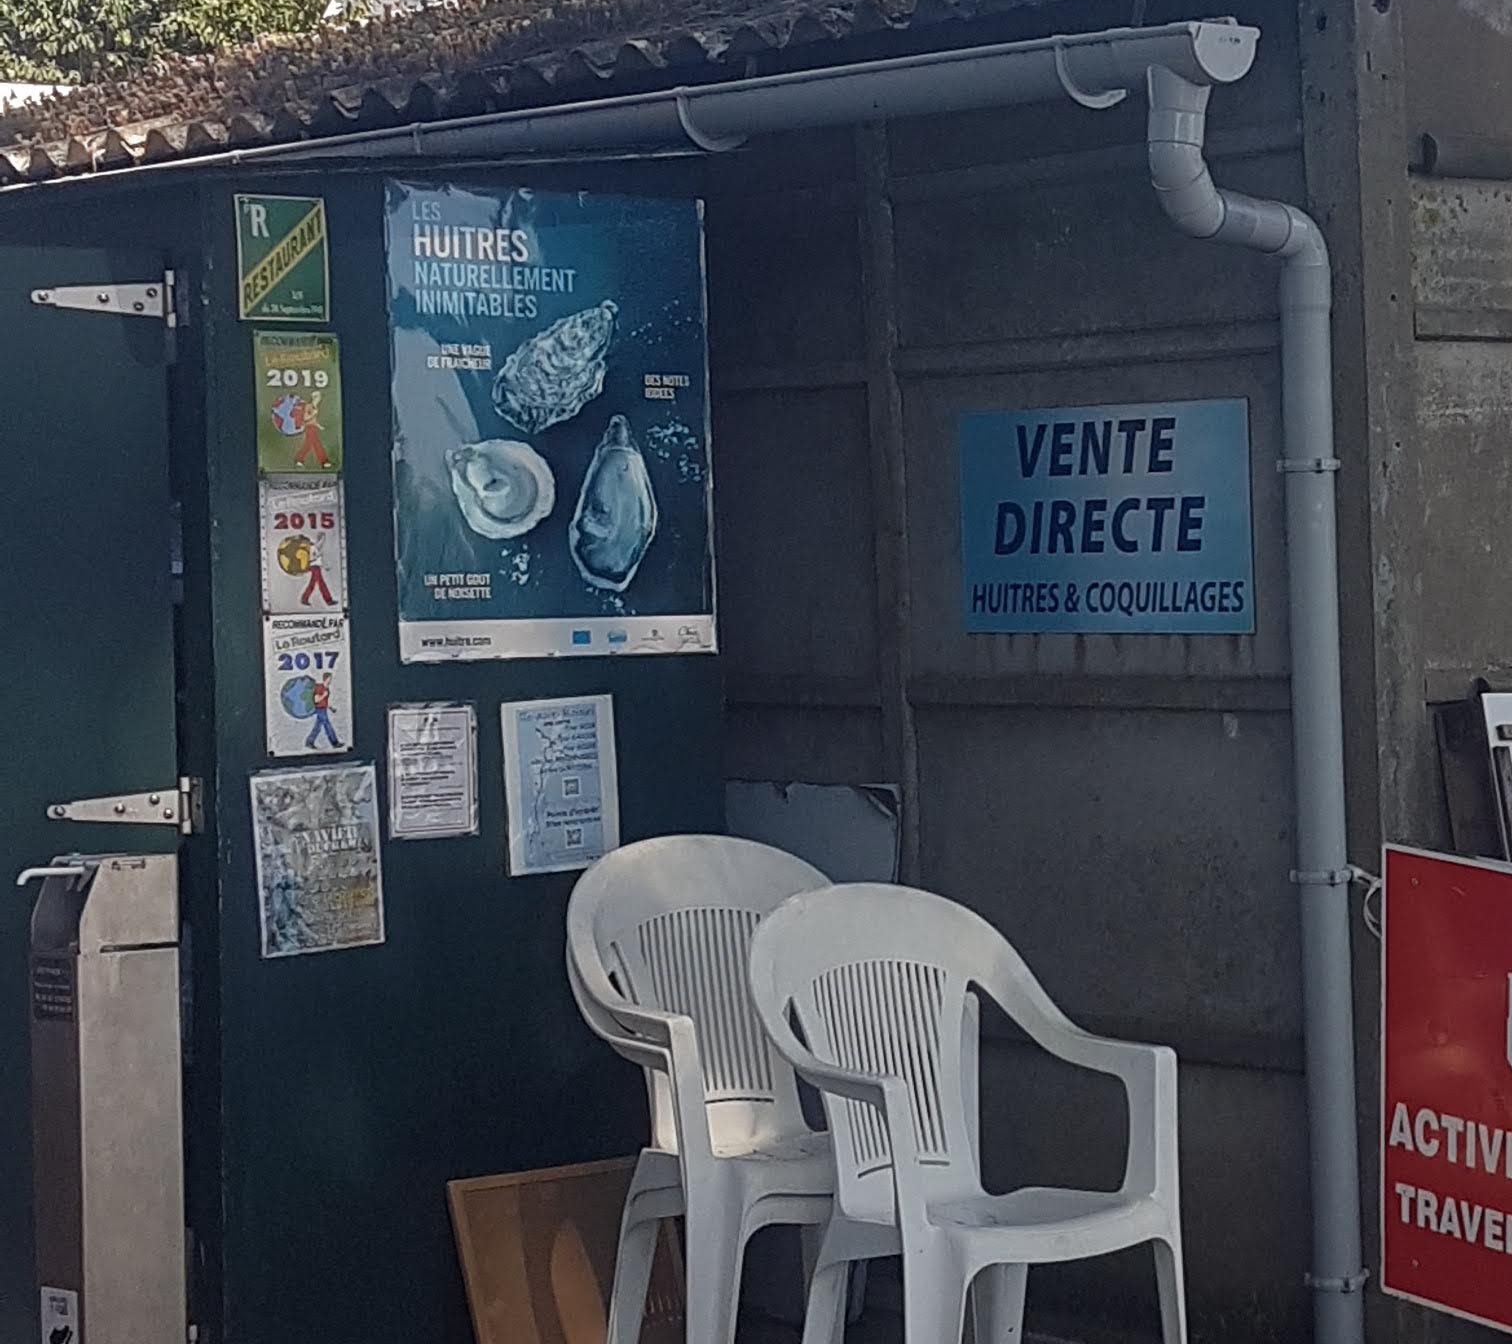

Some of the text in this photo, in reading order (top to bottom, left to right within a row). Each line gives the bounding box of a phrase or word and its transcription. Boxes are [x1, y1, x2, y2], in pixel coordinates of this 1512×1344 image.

[412, 201, 441, 222] LES
[413, 223, 529, 263] HUITRES
[243, 207, 321, 309] RESTAURANT
[414, 261, 576, 292] NATURELLEMENT
[415, 289, 537, 318] INIMITABLES
[428, 356, 440, 368] DE
[266, 369, 329, 388] 2019
[1017, 418, 1176, 478] VENTE
[274, 512, 335, 529] 2015
[994, 496, 1205, 555] DIRECTE
[440, 574, 465, 585] PETIT
[434, 587, 446, 599] DE
[972, 581, 1244, 616] HUITRES & COQUILLAGES
[278, 651, 339, 670] 2017
